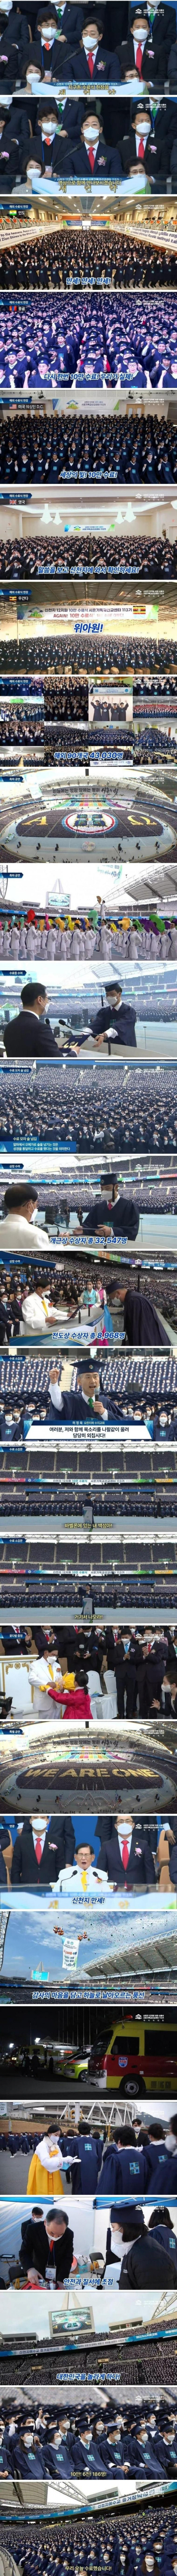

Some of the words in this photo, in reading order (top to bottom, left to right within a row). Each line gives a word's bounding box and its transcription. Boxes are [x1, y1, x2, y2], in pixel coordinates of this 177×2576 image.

[59, 185, 66, 193] 새
[109, 185, 118, 193] 약
[98, 2499, 121, 2508] 신천지예수교
